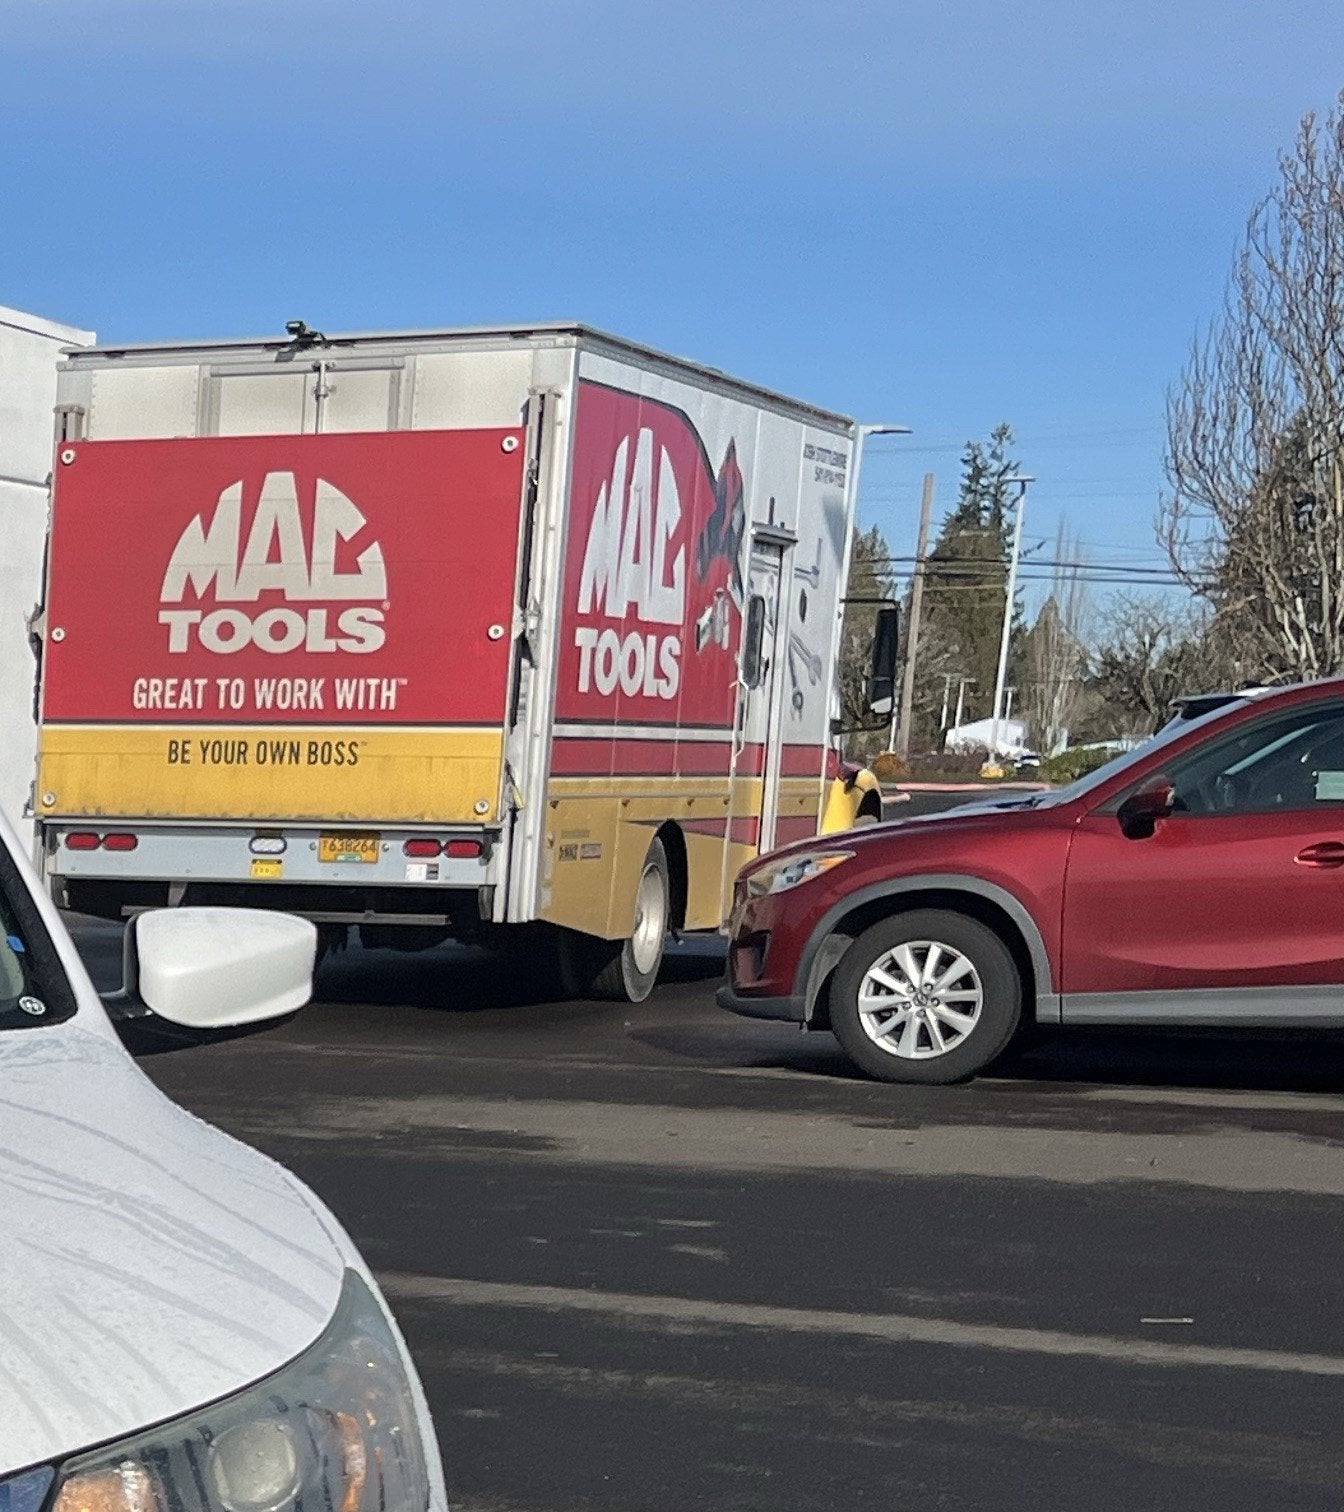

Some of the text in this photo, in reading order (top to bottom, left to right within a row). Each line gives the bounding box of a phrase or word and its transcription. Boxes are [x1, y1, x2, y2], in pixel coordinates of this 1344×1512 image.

[159, 470, 388, 602] MAC
[577, 427, 686, 625] MAC
[158, 607, 387, 654] TOOLS
[574, 627, 682, 700] TOOLS
[132, 679, 207, 710] GREAT
[216, 679, 245, 709] TO
[252, 679, 324, 710] WORK
[167, 740, 360, 766] BE YOUR OWN BOSS
